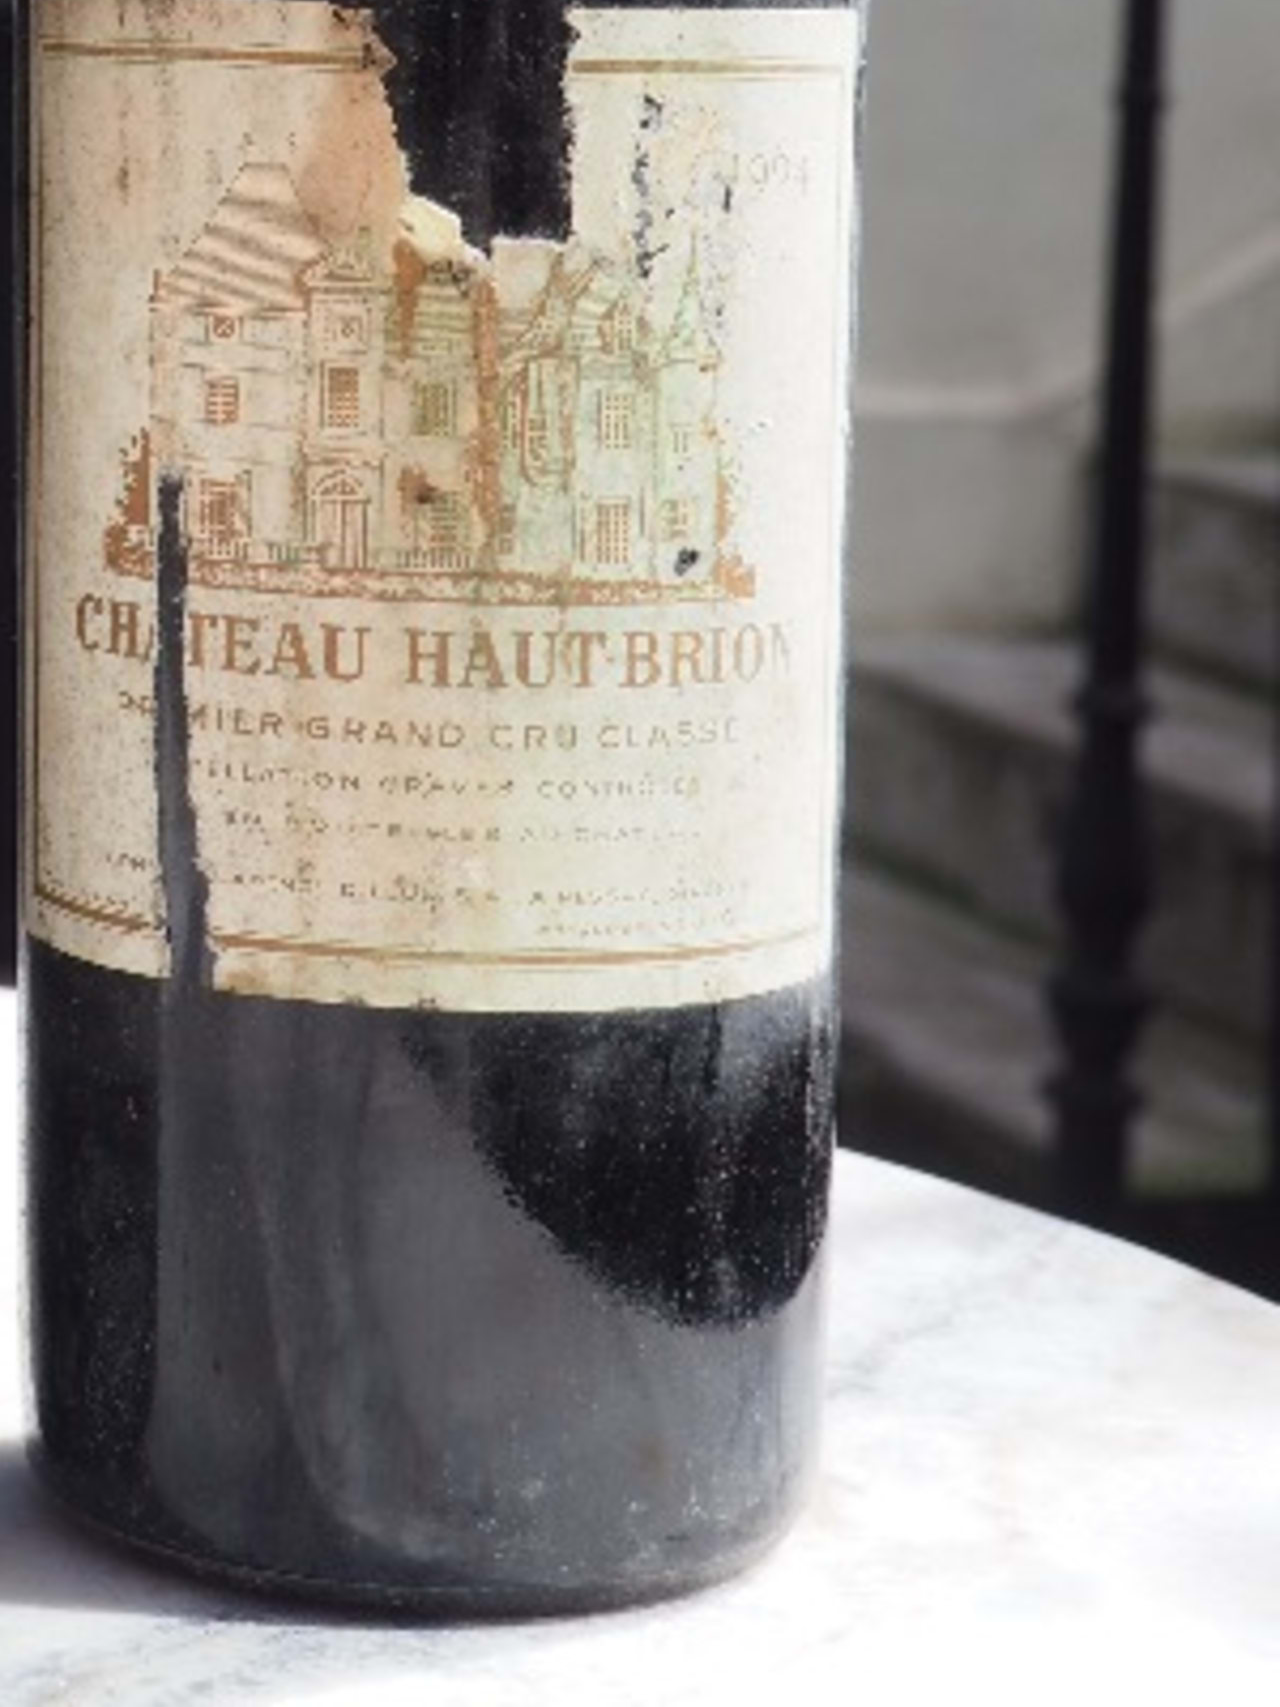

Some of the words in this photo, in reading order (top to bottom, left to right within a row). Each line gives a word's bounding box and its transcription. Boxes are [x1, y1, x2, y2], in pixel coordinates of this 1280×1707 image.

[403, 622, 791, 690] HAUT-BRION
[305, 716, 466, 750] GRAND
[488, 724, 579, 750] CRU
